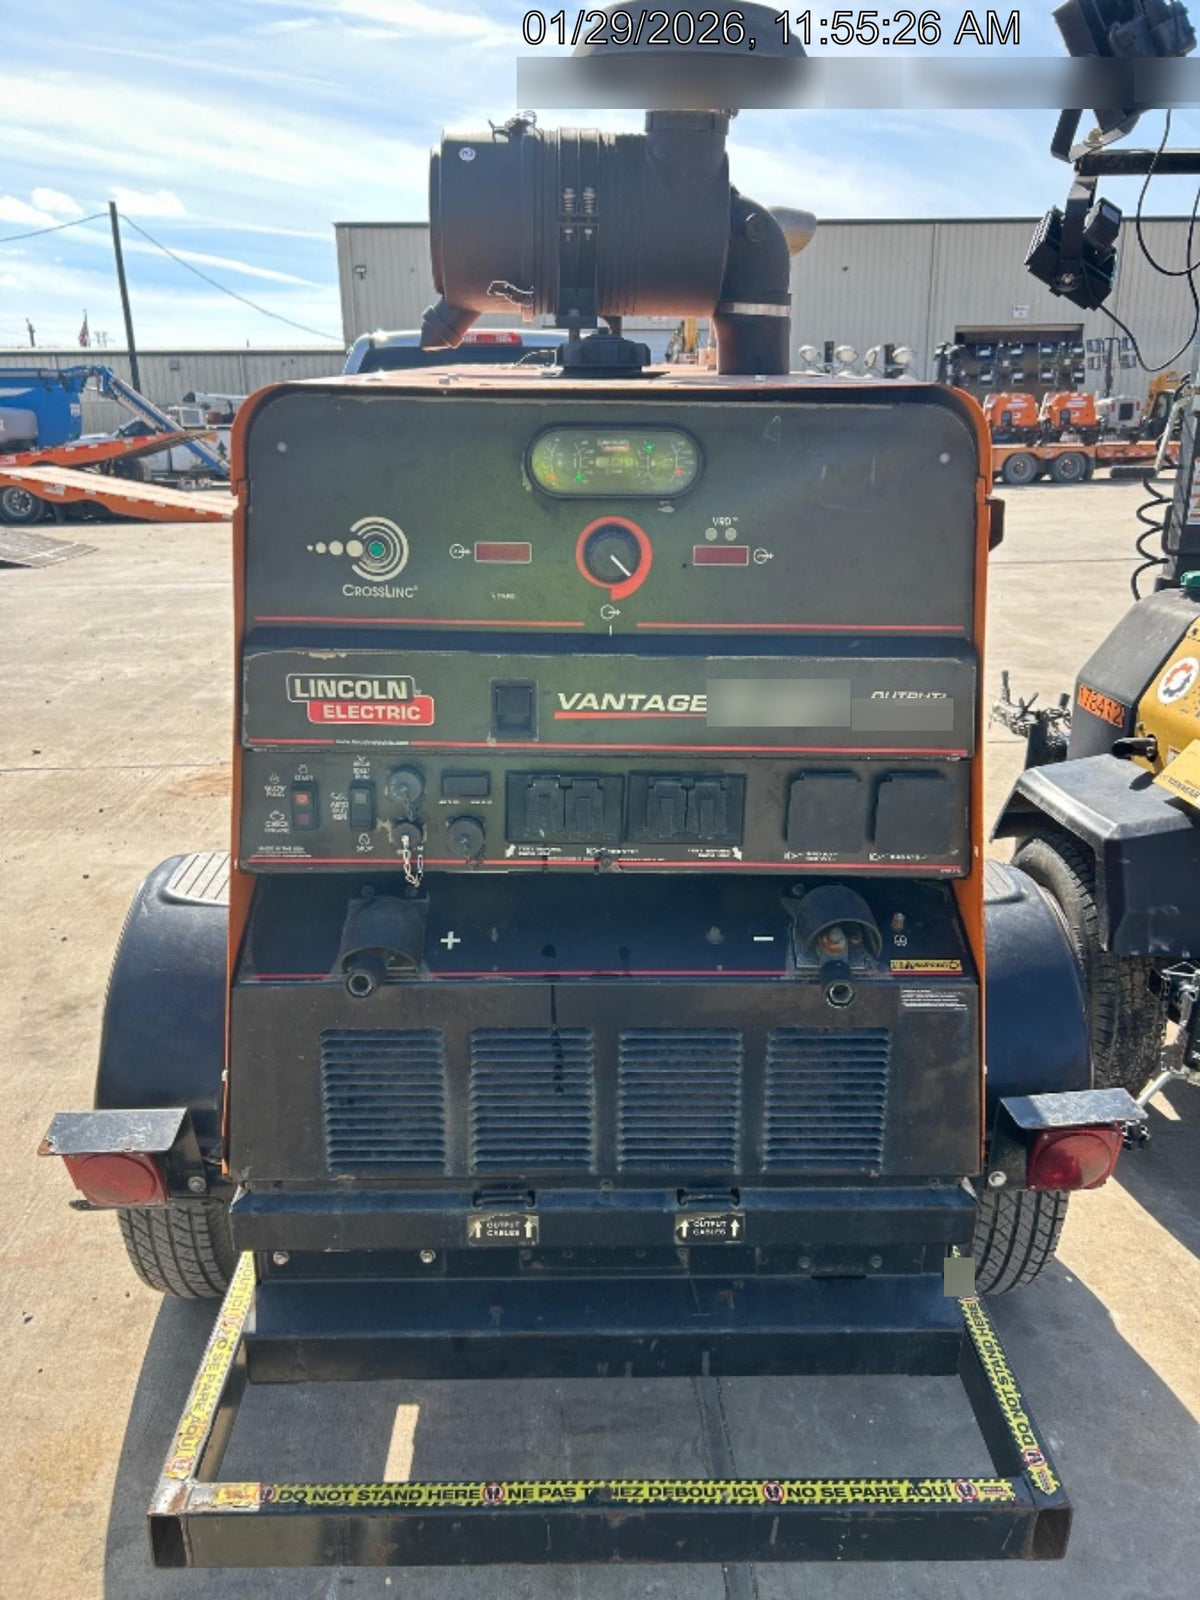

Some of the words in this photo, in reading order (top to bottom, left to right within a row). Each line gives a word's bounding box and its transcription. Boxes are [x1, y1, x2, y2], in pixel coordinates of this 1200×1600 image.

[294, 678, 408, 700] LINCOLN
[322, 704, 421, 720] ELECTRIC
[557, 692, 707, 712] VANTAGE
[982, 1339, 1009, 1385] STAND
[1001, 1389, 1023, 1419] NOT
[1016, 1422, 1036, 1446] DO
[278, 1489, 308, 1502] DO
[312, 1489, 354, 1501] NOT
[356, 1489, 423, 1501] STAND
[427, 1489, 480, 1500] HERE
[508, 1487, 534, 1499] NE
[539, 1487, 577, 1498] PAS
[649, 1487, 728, 1498] DEBOUT
[733, 1487, 758, 1497] ICI
[787, 1487, 817, 1498] NO
[820, 1487, 846, 1498] SE
[850, 1487, 901, 1498] PARE
